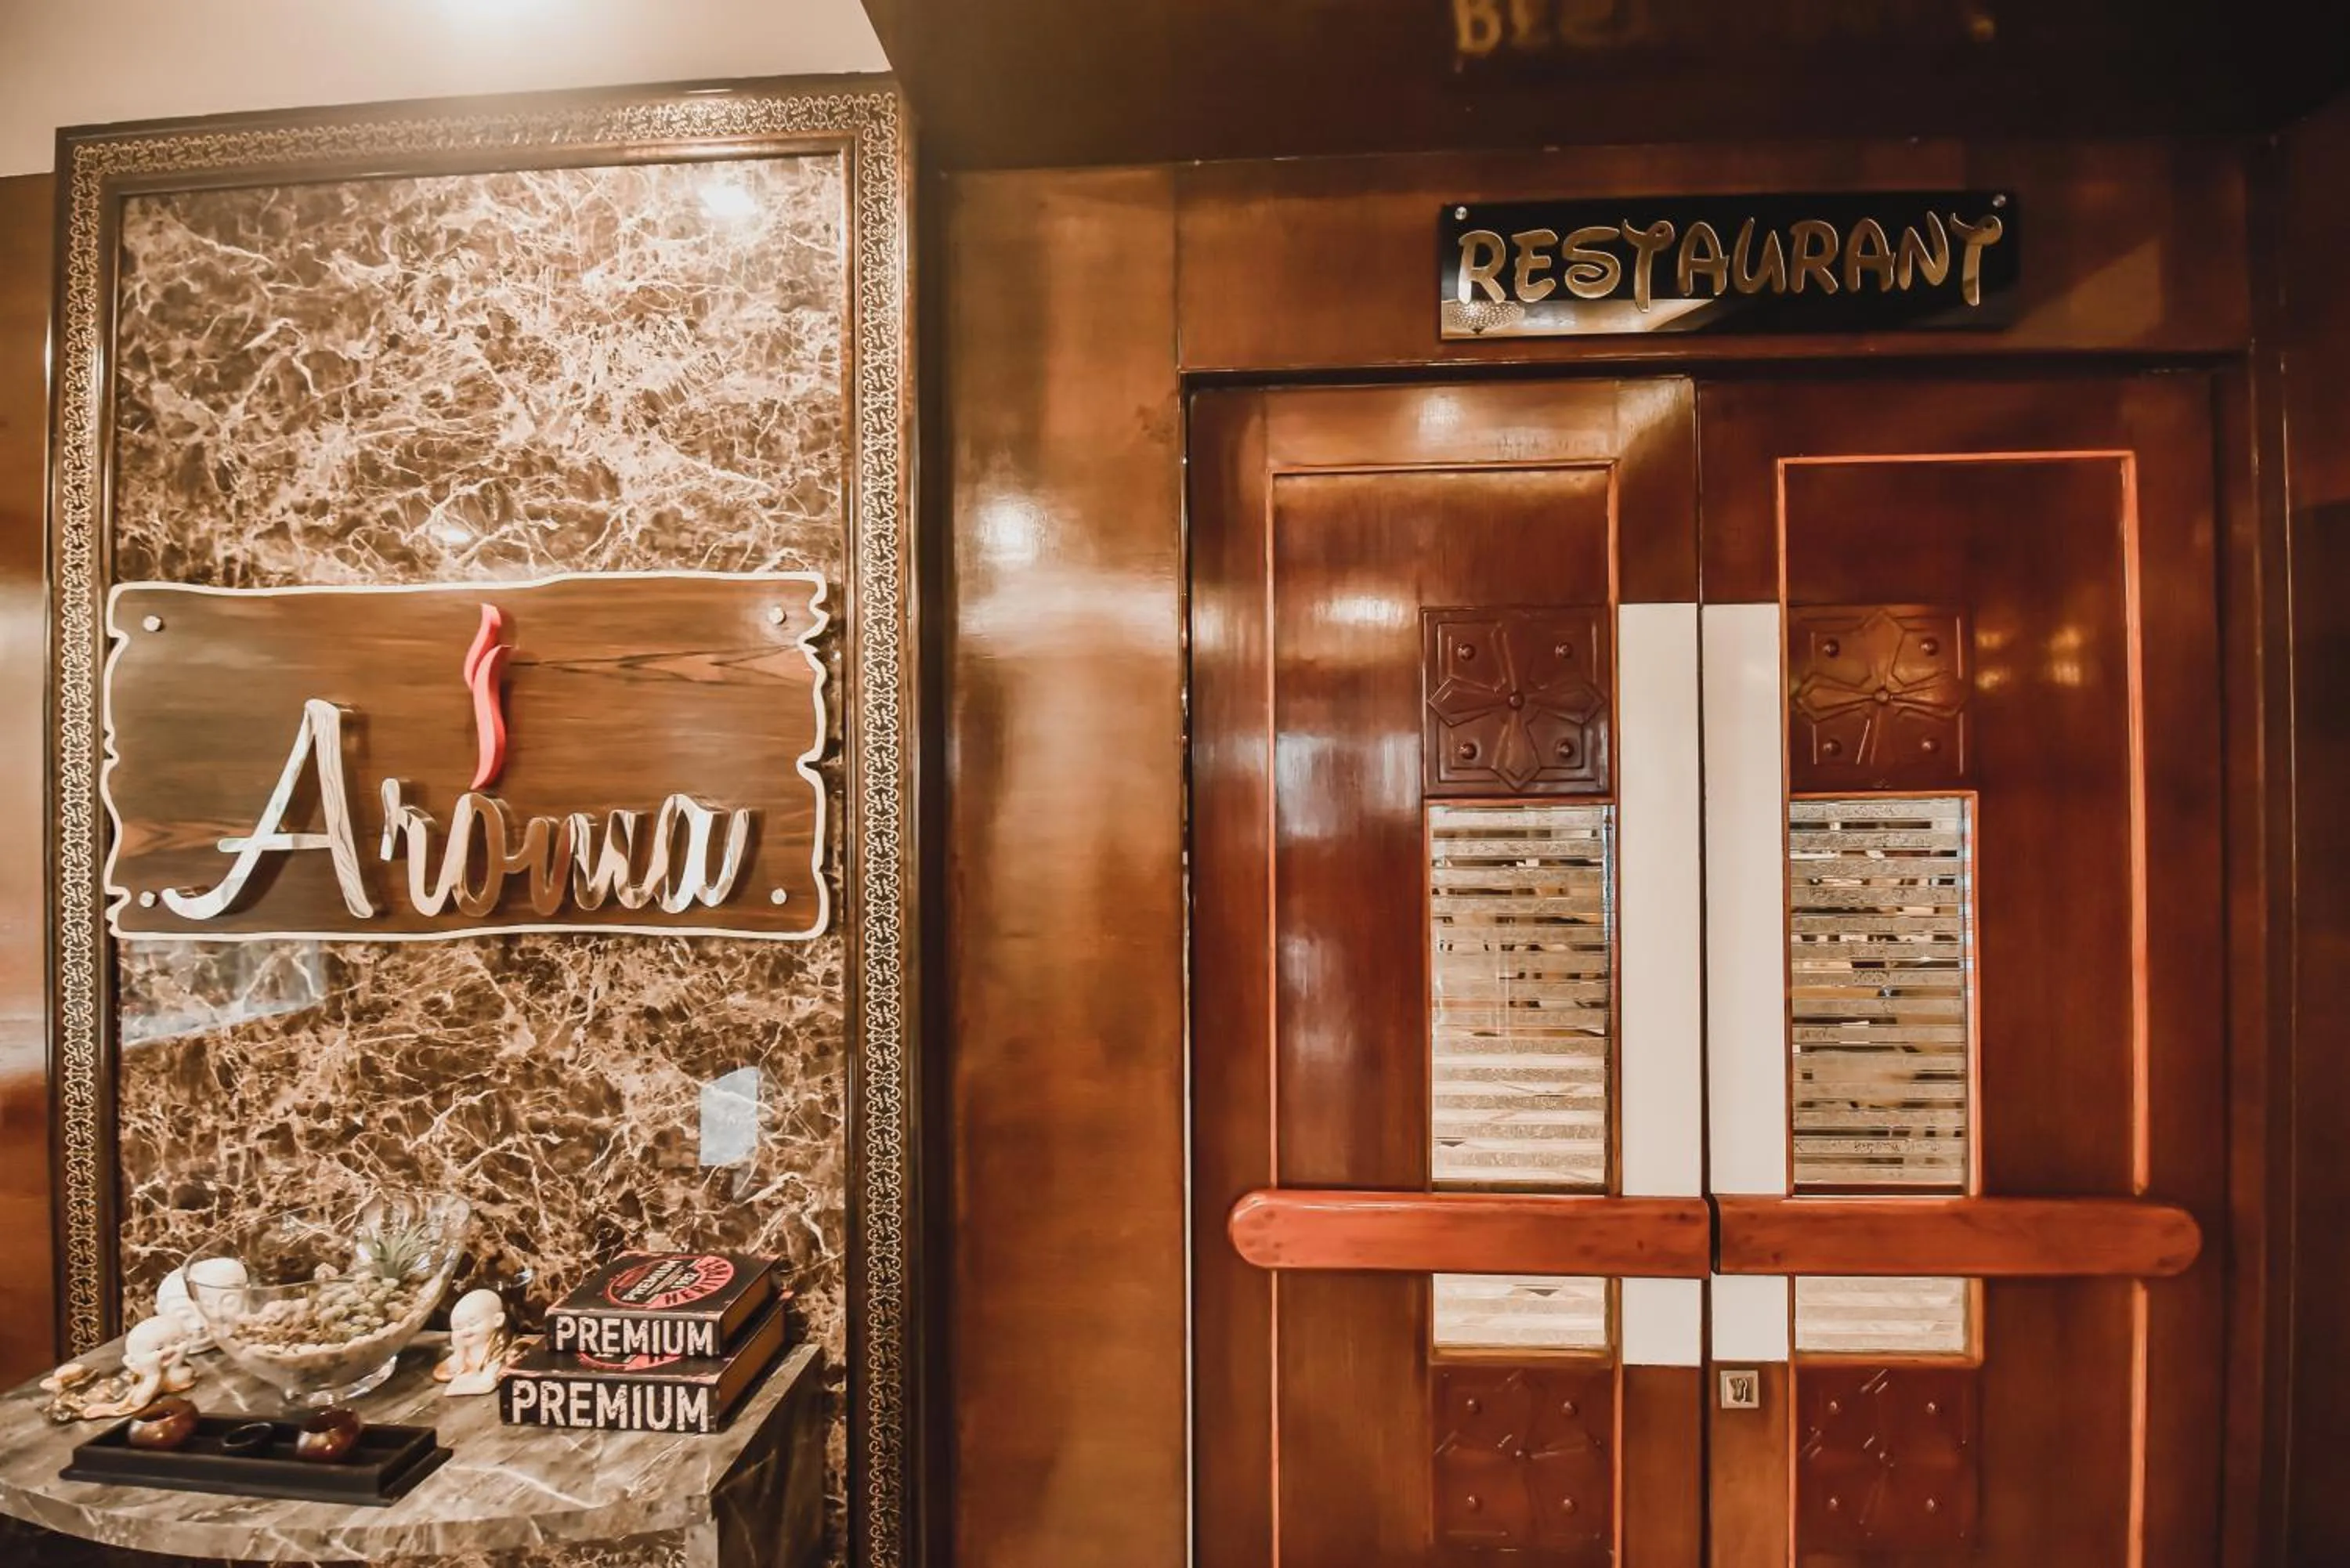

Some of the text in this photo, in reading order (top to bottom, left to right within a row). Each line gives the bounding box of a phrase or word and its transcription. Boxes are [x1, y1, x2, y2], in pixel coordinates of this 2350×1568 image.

[1457, 211, 2004, 313] RESTAURANT
[161, 699, 750, 919] Aroma
[621, 1259, 683, 1301] PREMIUM
[555, 1316, 713, 1357] PREMIUM
[512, 1379, 708, 1433] PREMIUM
